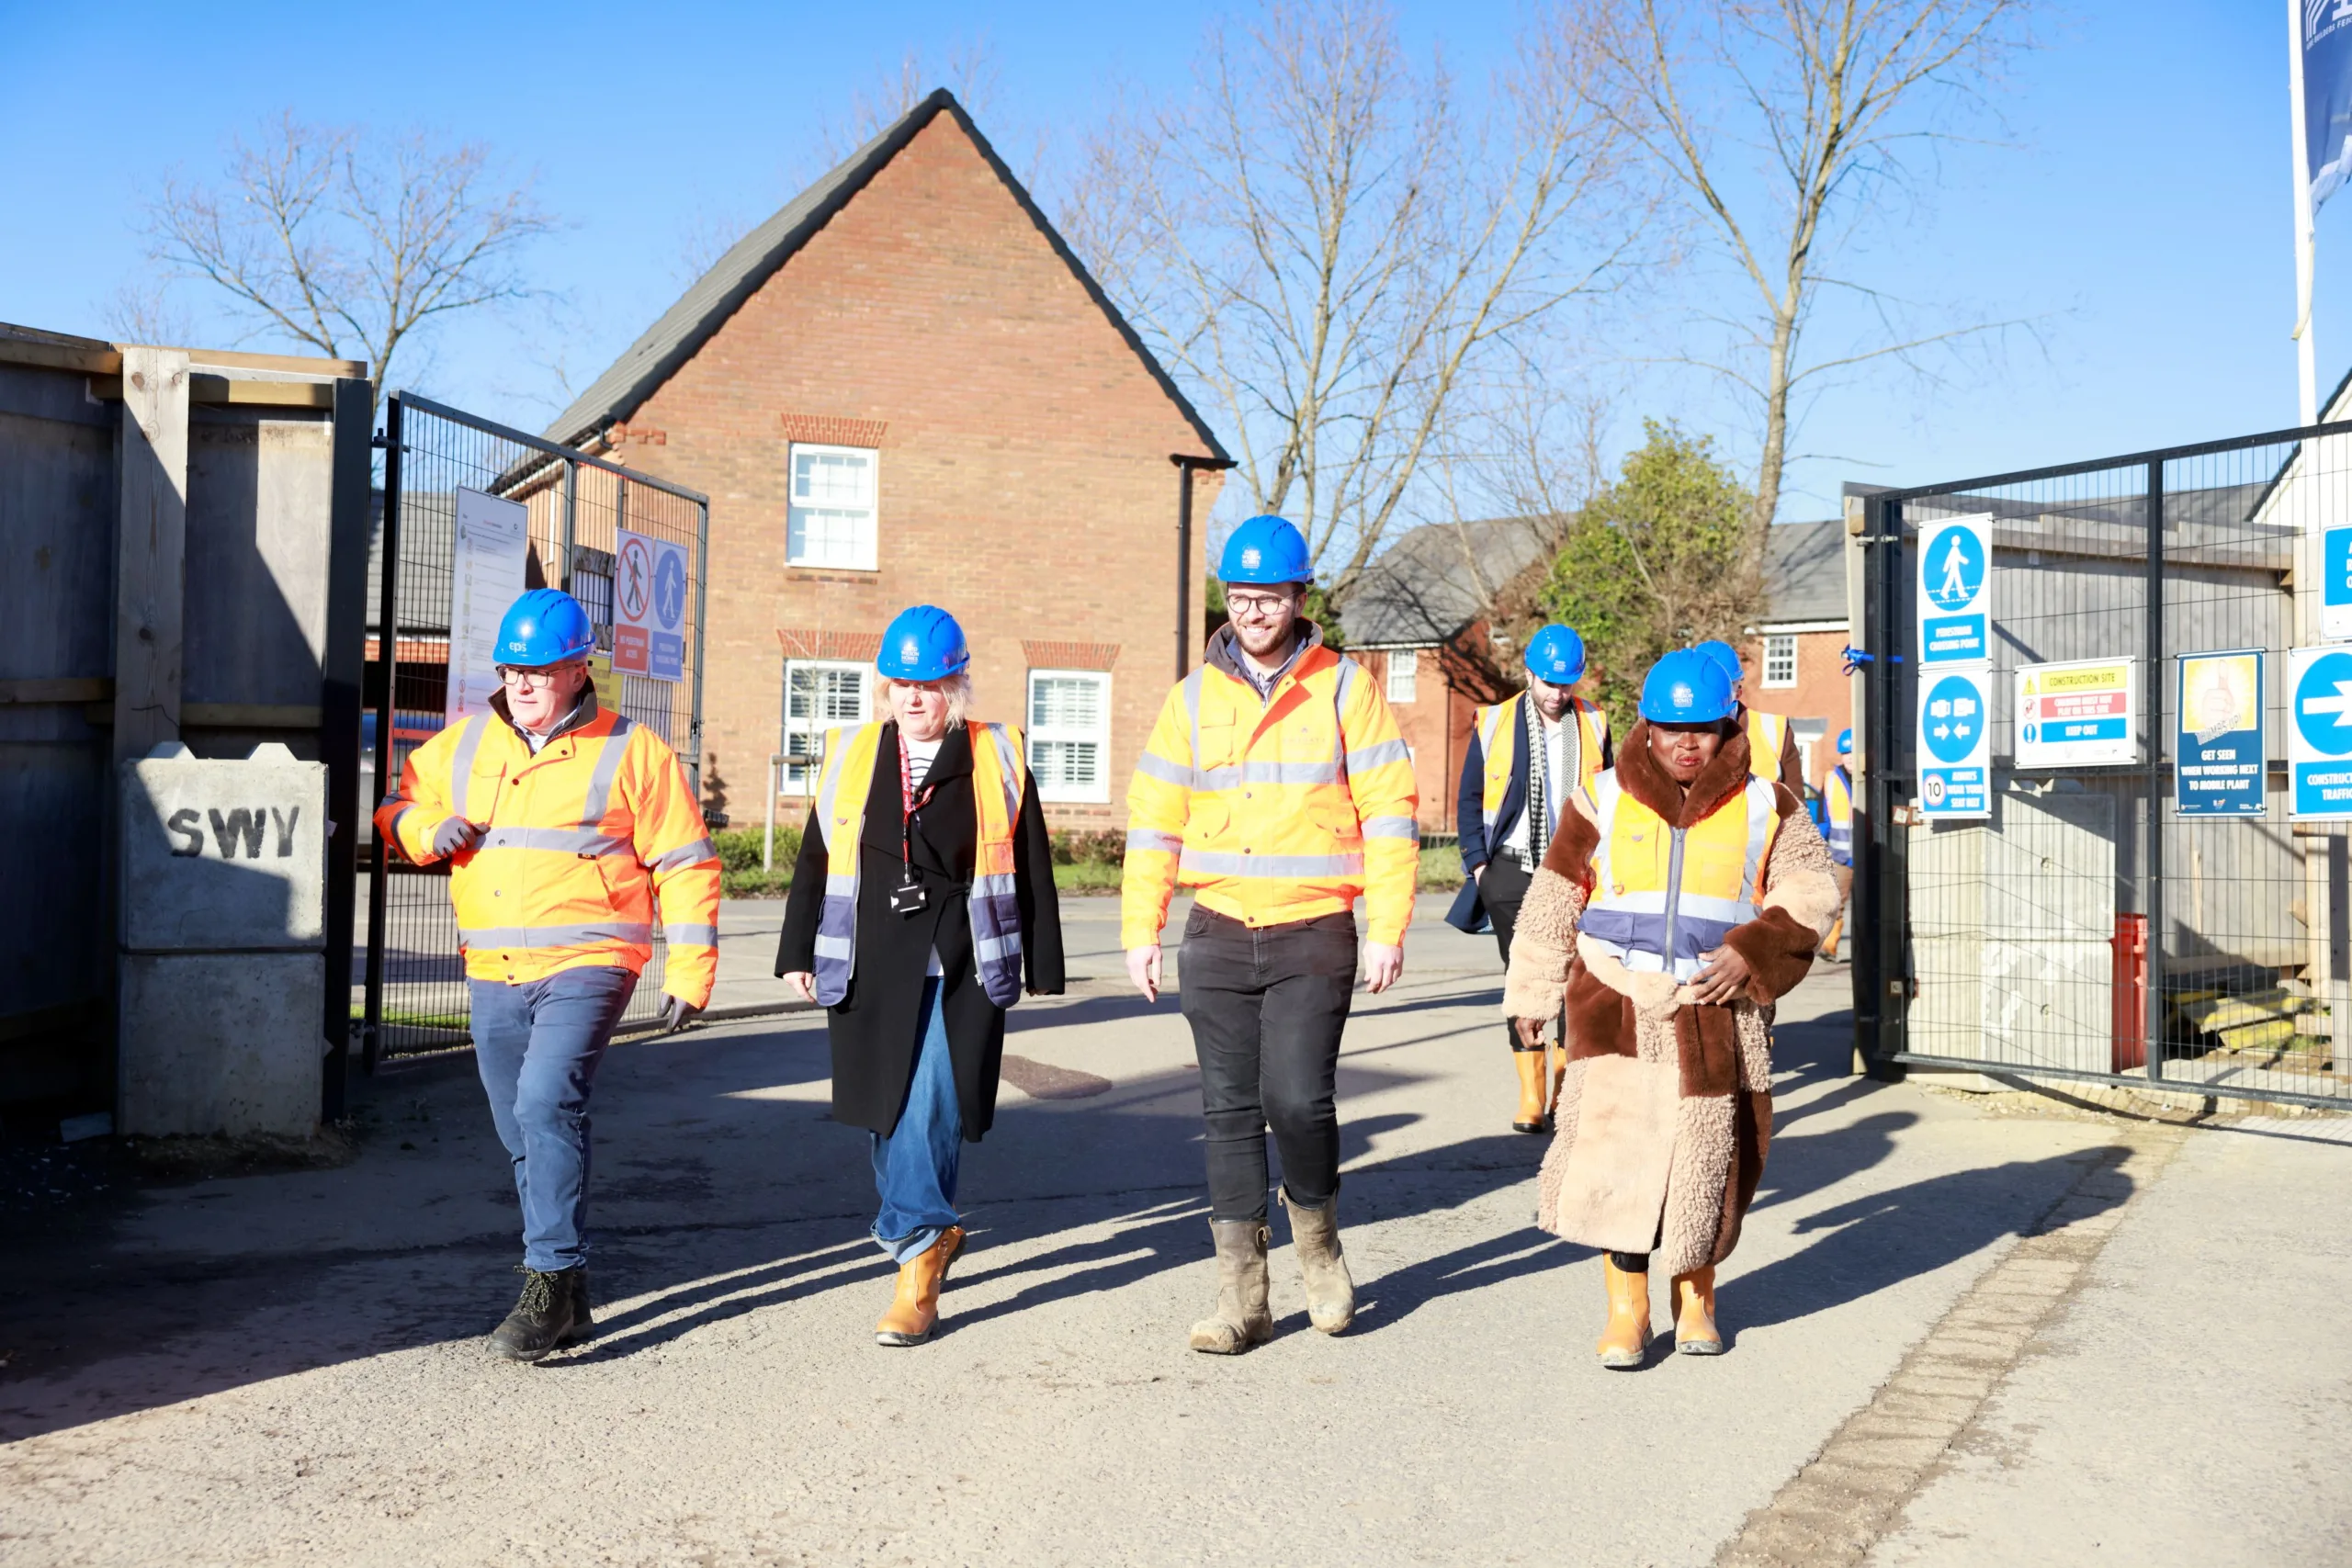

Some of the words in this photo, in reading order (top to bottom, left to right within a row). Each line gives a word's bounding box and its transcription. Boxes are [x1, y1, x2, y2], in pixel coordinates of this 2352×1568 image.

[509, 642, 527, 653] eps
[2049, 674, 2099, 686] CONSTRUCTION
[2101, 672, 2115, 683] SITE
[2201, 750, 2216, 761] GET
[2217, 749, 2236, 761] SEEN
[2180, 765, 2202, 776] WHEN
[2202, 764, 2238, 775] WORKING
[2239, 763, 2259, 774] NEXT
[1928, 782, 1941, 797] 10
[2188, 780, 2199, 791] TO
[2199, 780, 2225, 791] MOBILE
[2226, 779, 2250, 790] PLANT
[167, 806, 300, 859] SWY
